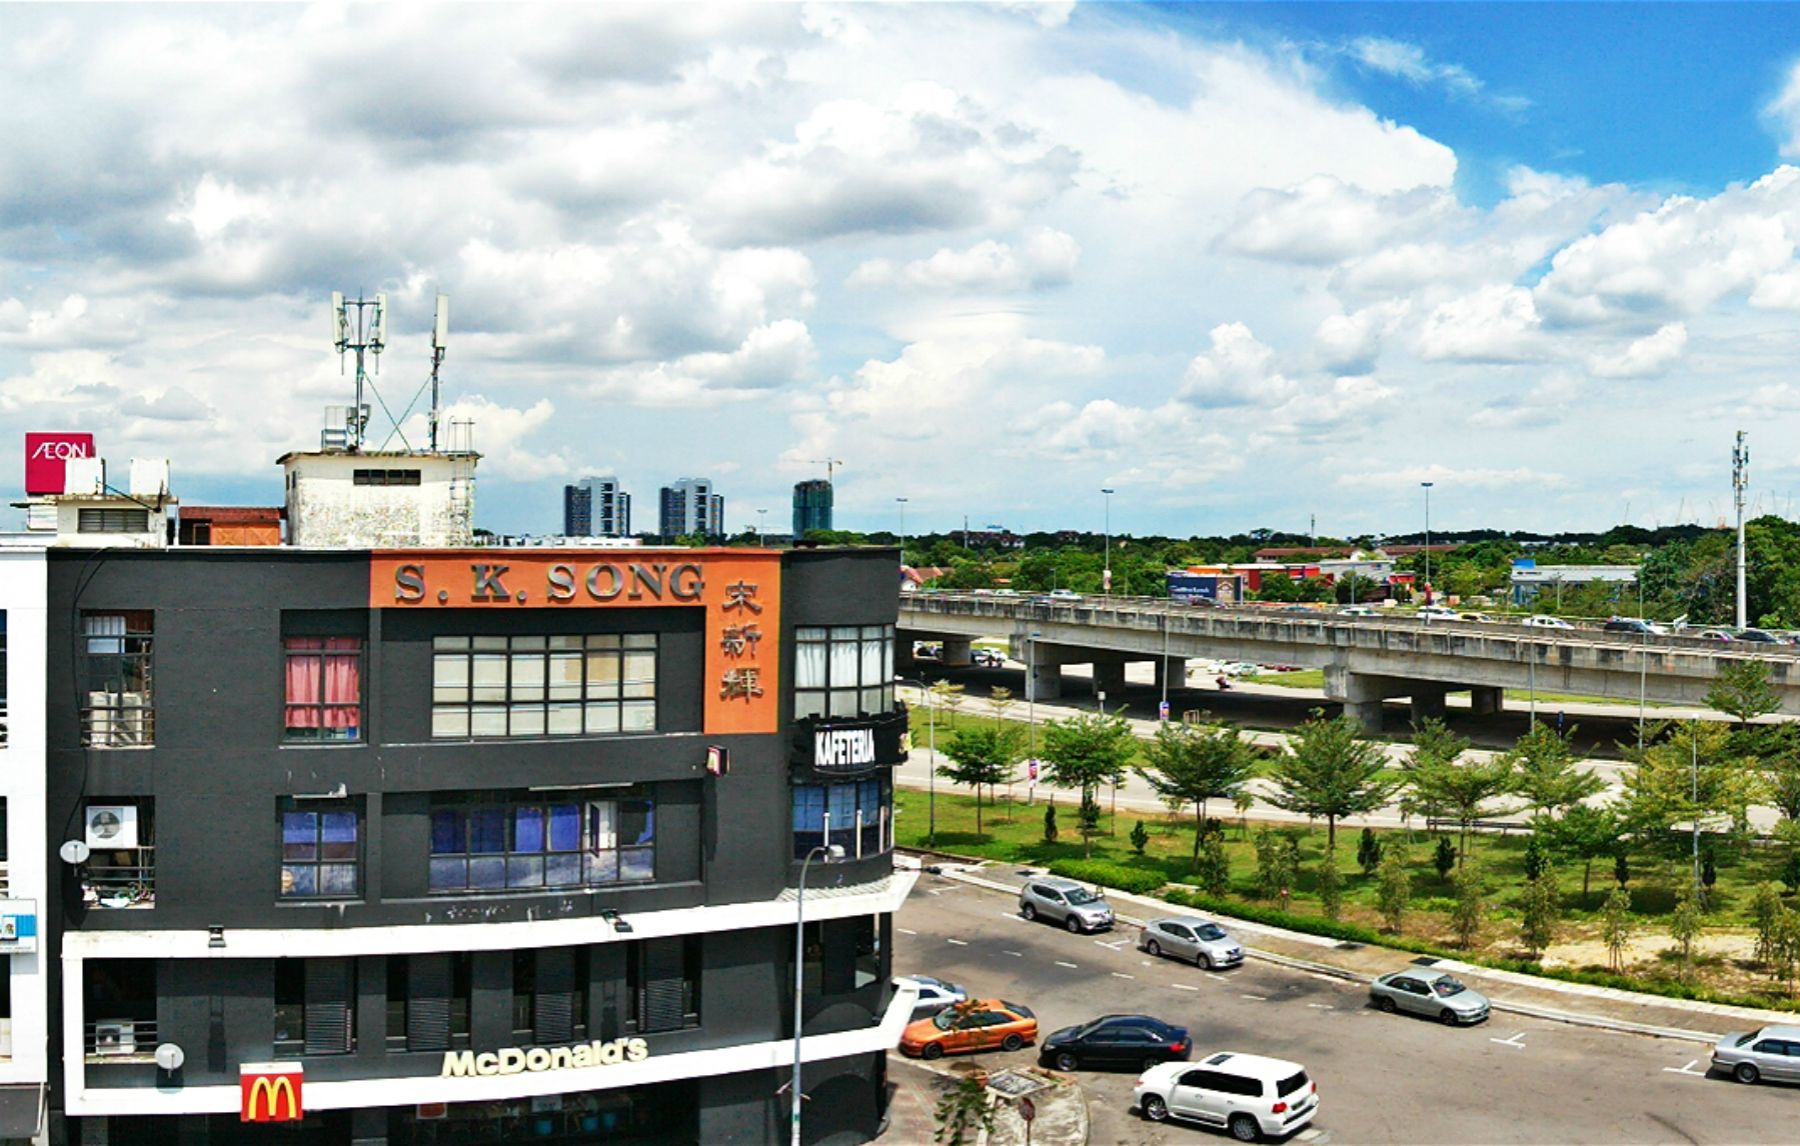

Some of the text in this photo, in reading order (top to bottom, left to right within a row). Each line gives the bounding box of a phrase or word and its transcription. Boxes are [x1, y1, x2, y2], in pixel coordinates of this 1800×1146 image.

[547, 562, 706, 602] SONG
[720, 580, 763, 704] 宋新輝
[815, 728, 875, 766] KAFETERIA
[442, 1038, 649, 1077] McDonald's
